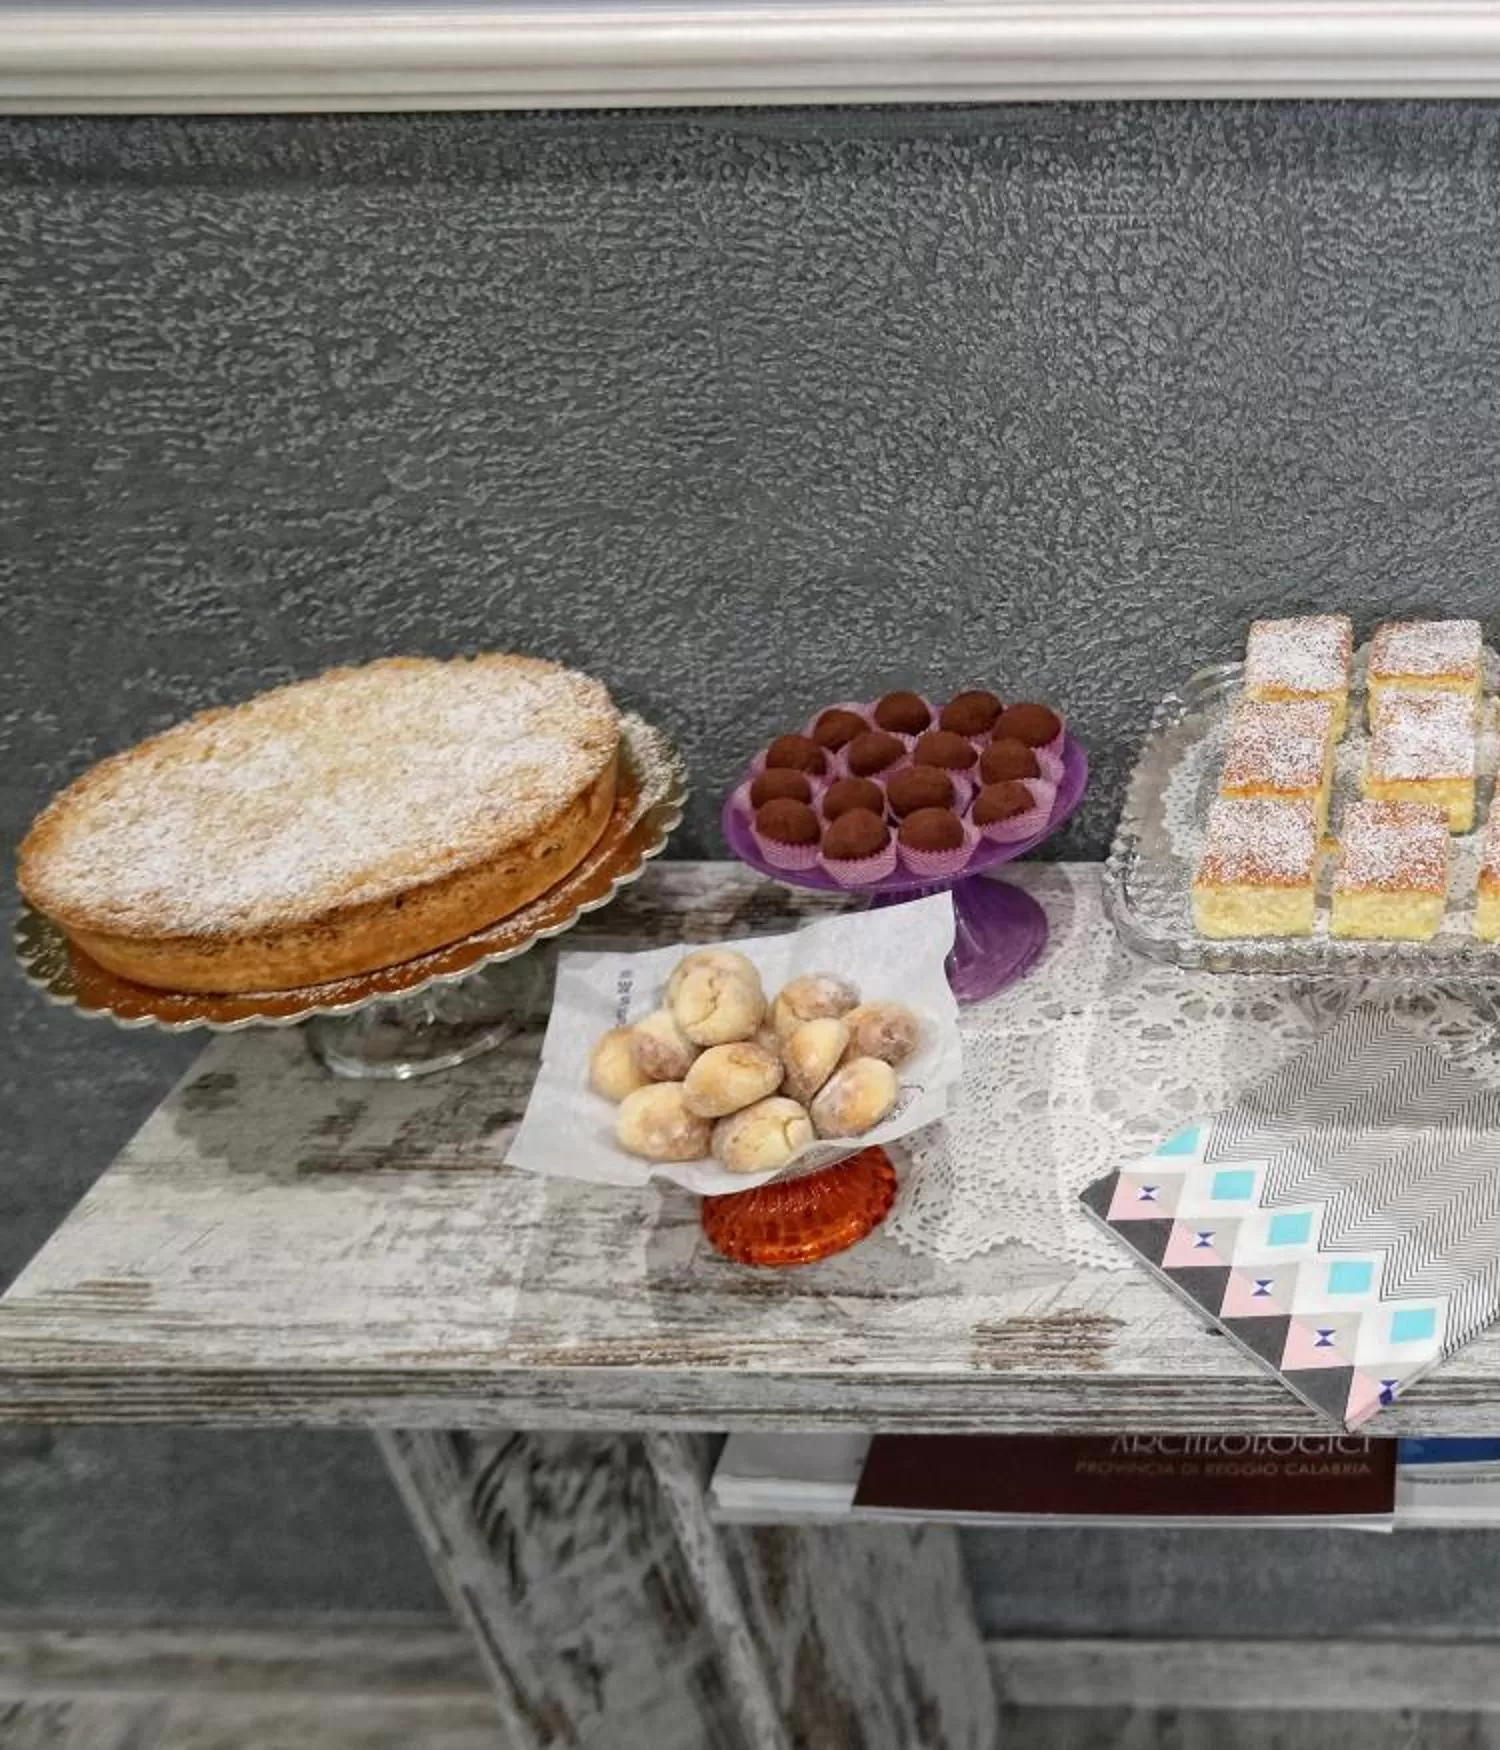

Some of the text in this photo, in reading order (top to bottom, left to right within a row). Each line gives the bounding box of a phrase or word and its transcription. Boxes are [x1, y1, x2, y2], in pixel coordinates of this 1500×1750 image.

[1074, 1460, 1372, 1477] PROVINCIA DI REGGIO CALABRIA
